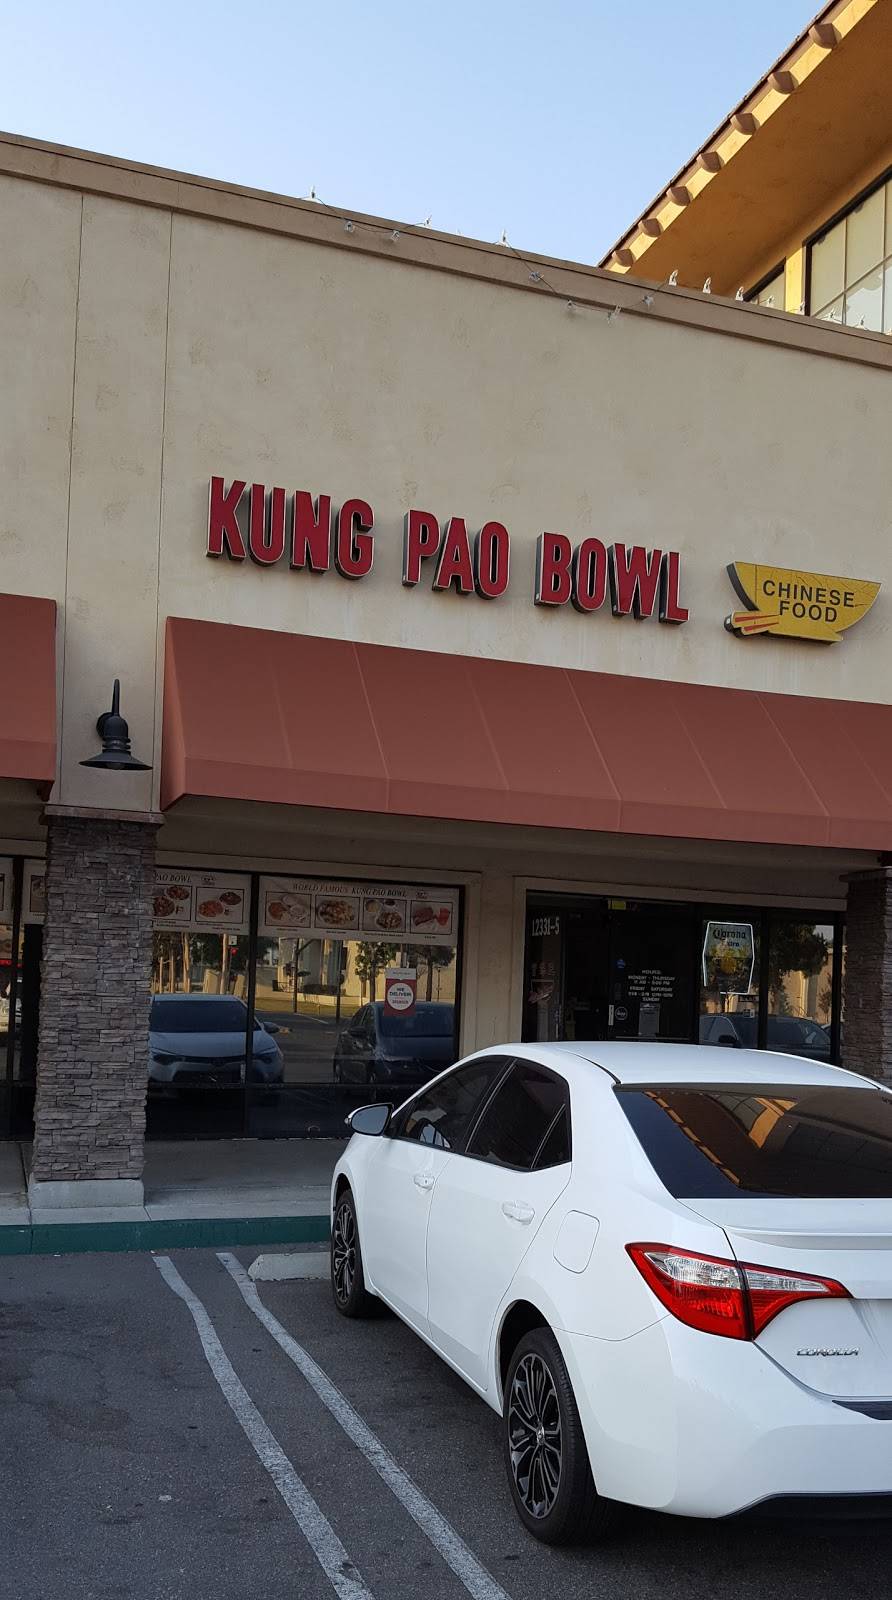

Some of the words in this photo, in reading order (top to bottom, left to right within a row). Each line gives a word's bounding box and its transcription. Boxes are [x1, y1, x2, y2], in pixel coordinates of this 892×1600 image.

[206, 475, 375, 579] KUNG
[403, 509, 511, 599] PAO
[535, 531, 690, 624] BOWL
[762, 580, 856, 608] CHINESE
[779, 600, 838, 623] FOOD
[169, 873, 192, 883] BOWL
[293, 882, 318, 892] WORLD
[319, 884, 349, 895] FAMOUS
[351, 886, 371, 896] KUNG
[371, 888, 386, 897] PAO
[387, 889, 408, 898] BOWL
[531, 916, 560, 937] 12331-5
[712, 927, 747, 940] Corona
[796, 1347, 859, 1357] COROLLA
